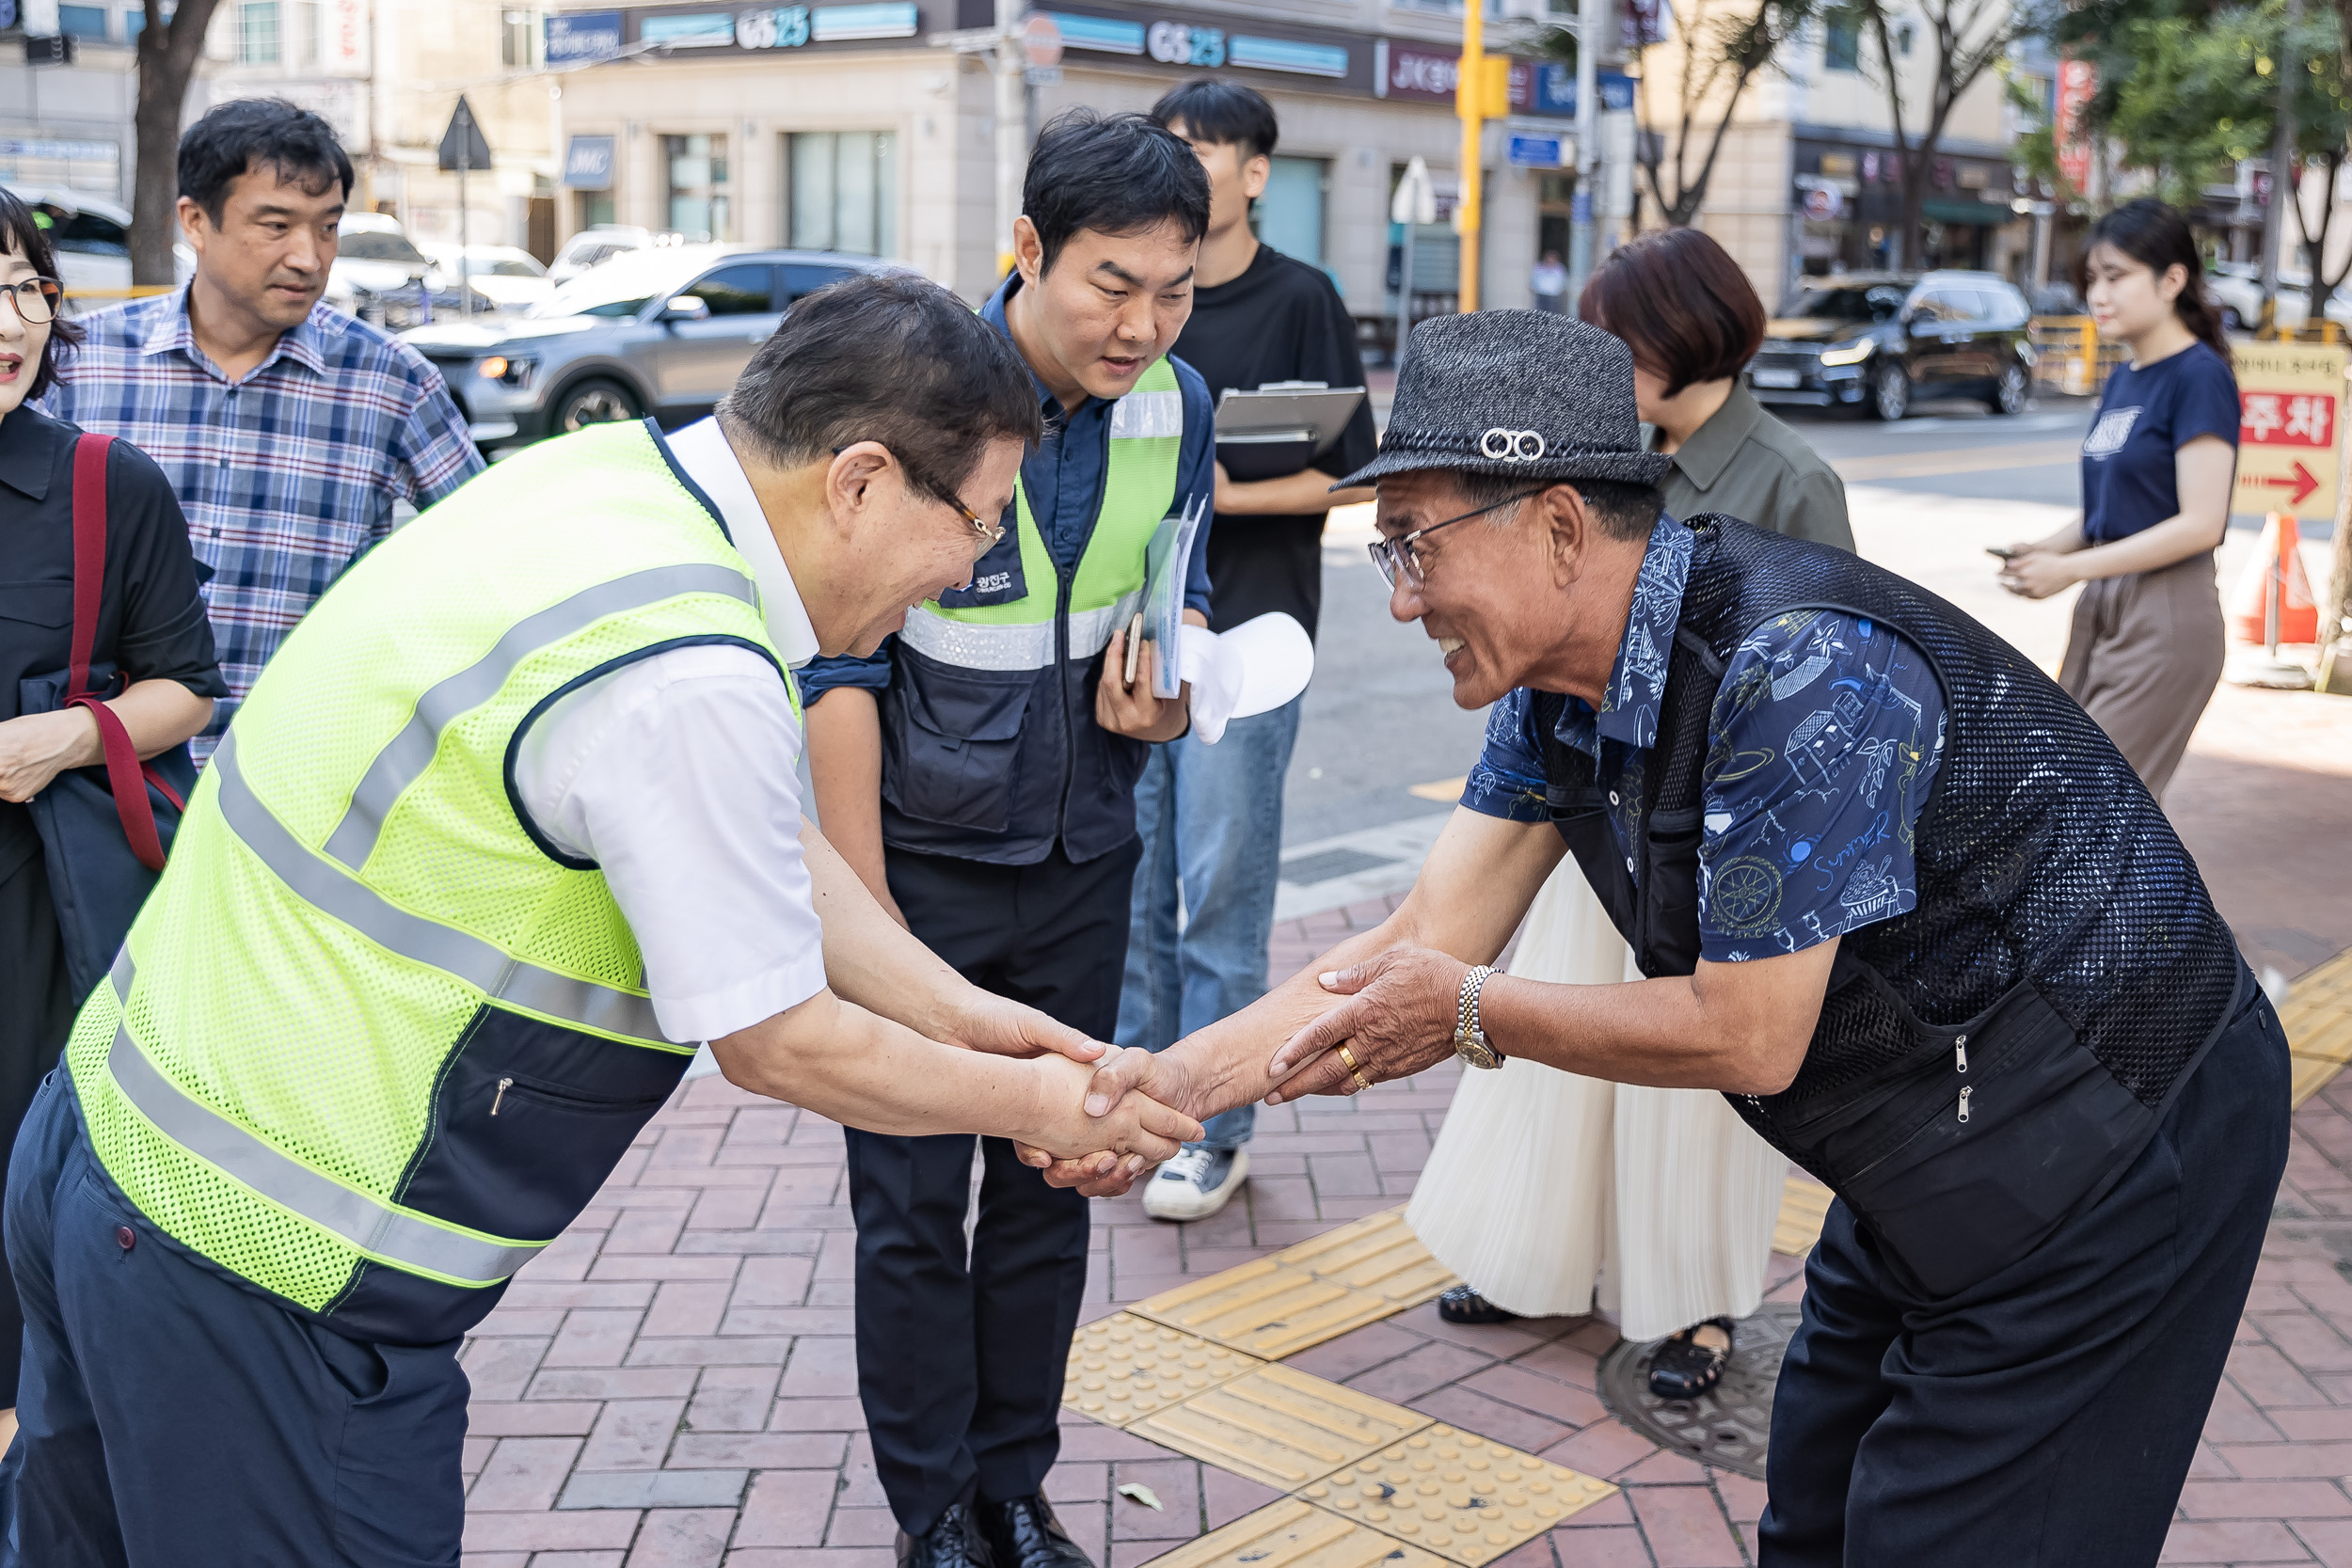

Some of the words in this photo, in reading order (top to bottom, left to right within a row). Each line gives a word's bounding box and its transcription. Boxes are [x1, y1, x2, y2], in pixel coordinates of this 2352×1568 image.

[736, 5, 810, 49] GS25
[1148, 21, 1226, 68] GS25
[2241, 394, 2331, 445] 주차
[976, 571, 1010, 588] 광진구
